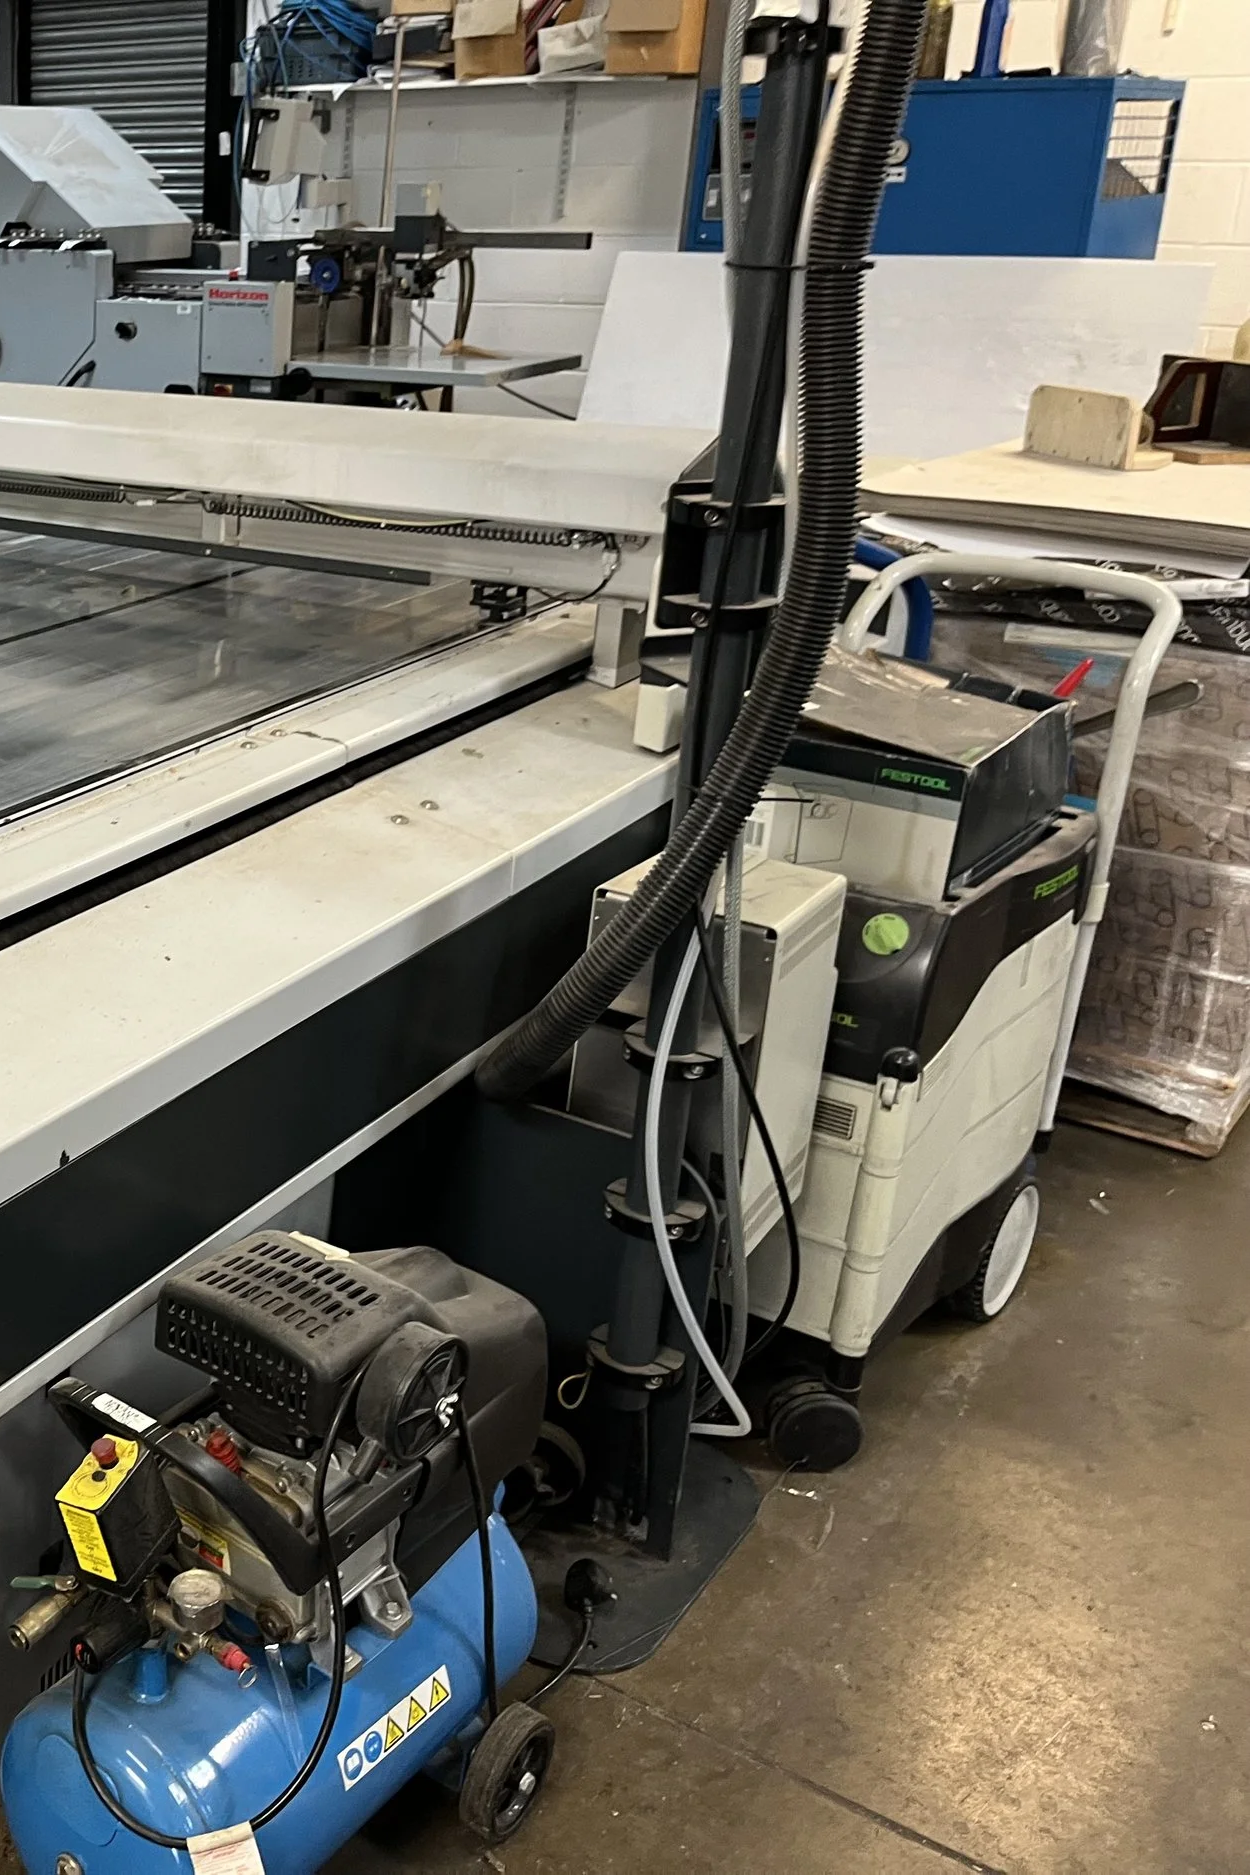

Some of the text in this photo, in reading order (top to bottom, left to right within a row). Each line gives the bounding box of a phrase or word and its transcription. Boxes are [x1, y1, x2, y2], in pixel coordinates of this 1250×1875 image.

[209, 287, 269, 301] Horizon
[881, 767, 951, 792] FESTOOL
[1033, 865, 1079, 900] FESTOOL
